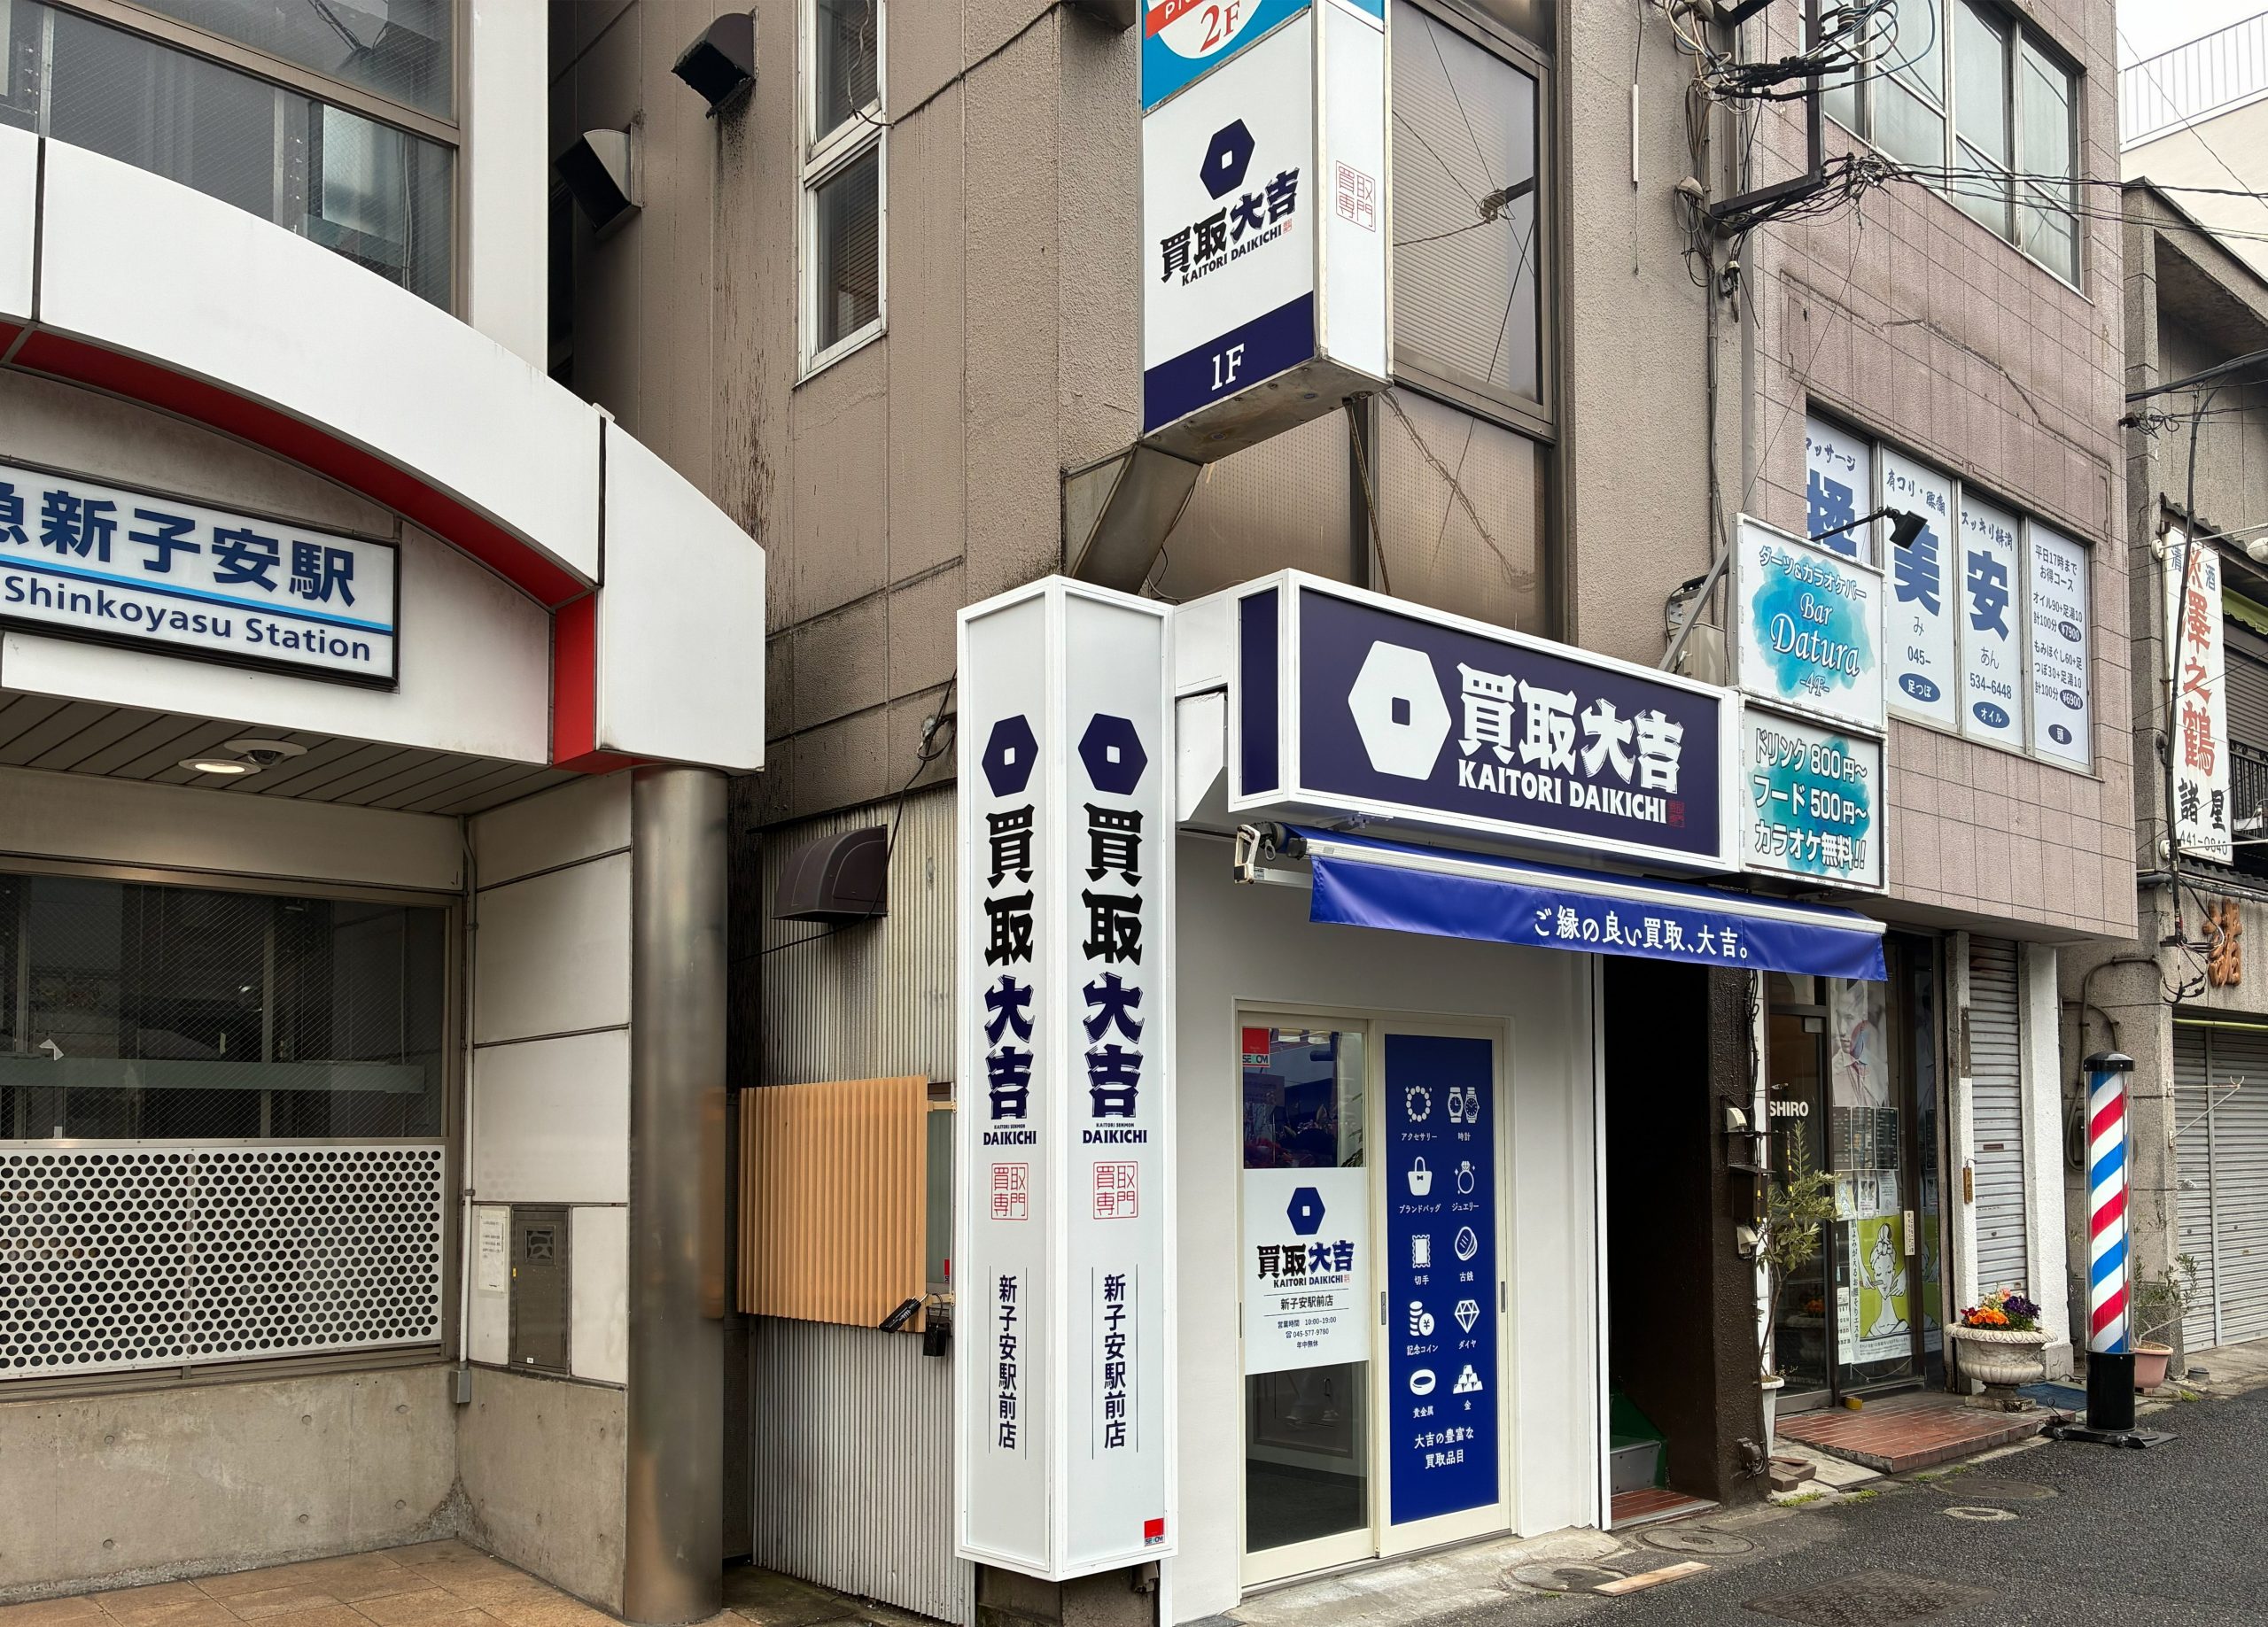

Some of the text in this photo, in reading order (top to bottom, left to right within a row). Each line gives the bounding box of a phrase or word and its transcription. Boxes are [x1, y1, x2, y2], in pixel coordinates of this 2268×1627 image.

[1200, 1, 1240, 53] 2F
[1339, 166, 1372, 203] 買取
[1339, 191, 1372, 228] 専門
[1160, 167, 1300, 283] 買取大吉
[1182, 223, 1282, 286] KAITORI DAIKICHI
[1211, 344, 1245, 391] 1F
[2035, 544, 2078, 576] 平日17時まで
[1759, 546, 1867, 600] ダーツ&カラオケバー
[2039, 565, 2073, 593] お得コース
[1800, 592, 1833, 625] Bar
[1967, 550, 2009, 642] 安
[4, 576, 370, 662] Shinkoyasu Station
[1770, 612, 1860, 677] Datura
[1914, 616, 2000, 670] み あん
[1907, 646, 2012, 699] 045- 534-6448
[1907, 678, 1932, 698] 足つぼ
[1456, 662, 1684, 794] 買取大吉
[1980, 708, 2002, 724] オイル
[1756, 728, 1806, 771] ドリンク
[1458, 758, 1562, 805] KAITORI
[1569, 780, 1666, 824] DAIKICHI
[1753, 775, 1806, 816] フード
[1534, 904, 1748, 959] ご縁の良い買取、大吉。
[983, 803, 1036, 1120] 買取大吉
[1081, 802, 1145, 1118] 買取大吉
[1242, 1054, 1269, 1064] SEOM
[1770, 1101, 1809, 1117] SHIRO
[983, 1130, 1037, 1145] DAIKICHI
[1083, 1129, 1147, 1143] DAIKICHI
[1457, 1132, 1471, 1141] 時計
[993, 1166, 1026, 1191] 買取
[1097, 1166, 1135, 1189] 買取
[993, 1192, 1026, 1217] 専門
[1097, 1191, 1135, 1216] 専門
[1399, 1203, 1441, 1213] ブランドバッグ
[1451, 1202, 1480, 1212] ジュエリー
[1256, 1240, 1355, 1280] 買取大吉
[1273, 1277, 1307, 1289] KAITORI
[1309, 1274, 1343, 1286] DAIKICHI
[1414, 1274, 1429, 1285] 切手
[1459, 1271, 1473, 1282] 古銭
[1280, 1294, 1334, 1311] 新子安駅前店
[1278, 1320, 1300, 1329] 営業時間
[1296, 1339, 1318, 1349] 年中無休
[1406, 1344, 1438, 1356] 記念コイン
[1458, 1339, 1476, 1350] ダイヤ
[998, 1274, 1018, 1450] 新子安駅前店
[1104, 1273, 1127, 1449] 新子安駅前店
[1413, 1406, 1433, 1419] 貴金属
[1464, 1399, 1472, 1410] 金
[1414, 1426, 1474, 1449] 大吉の豊富な
[1425, 1449, 1464, 1469] 買取品目
[1145, 1536, 1163, 1545] SEOM
